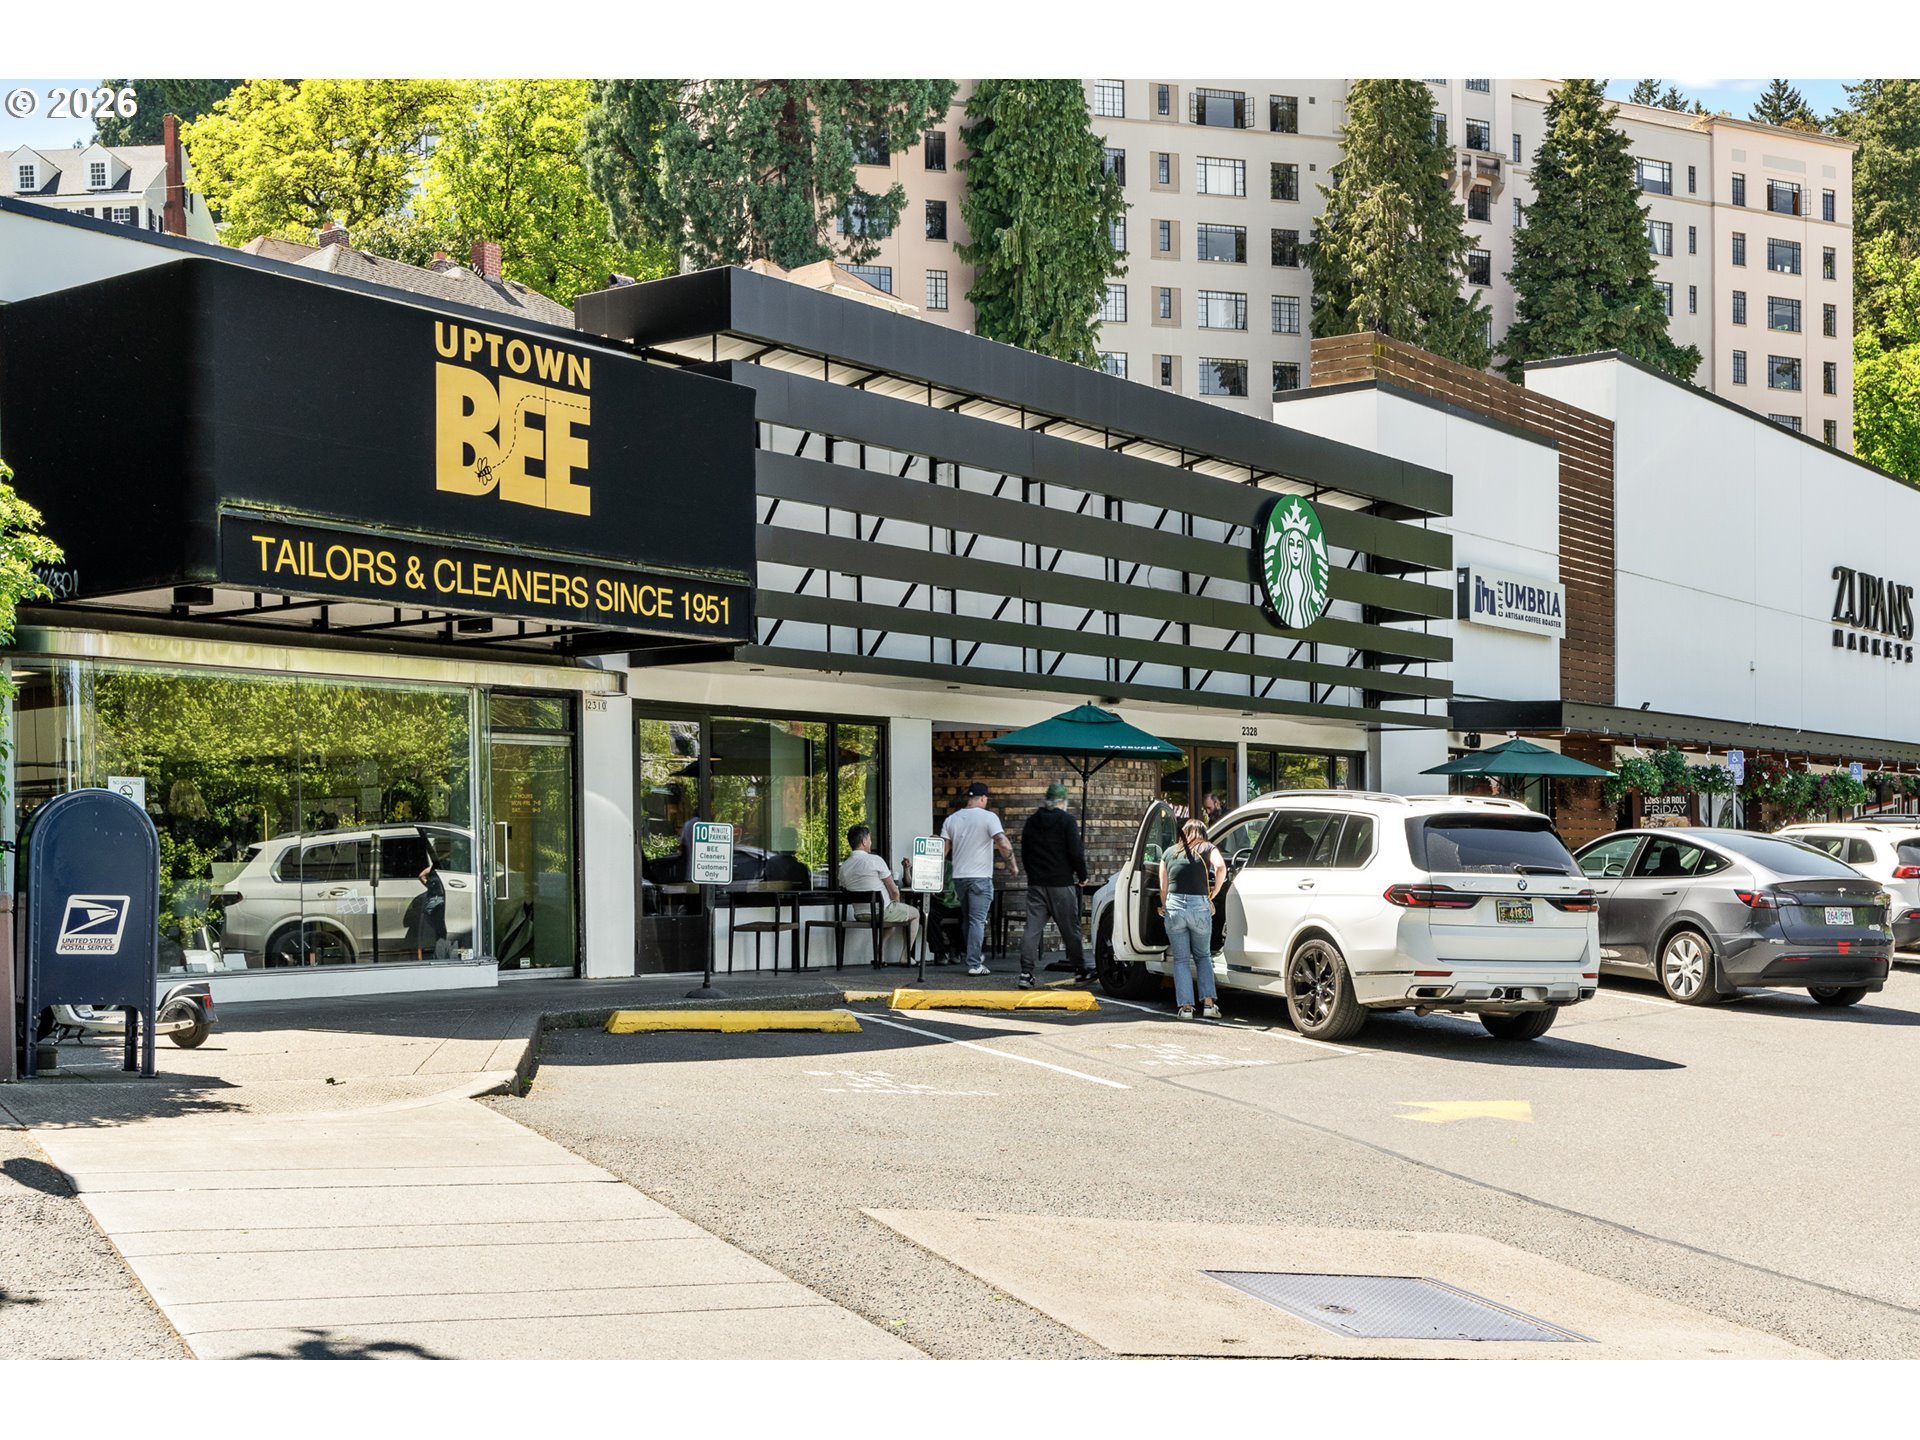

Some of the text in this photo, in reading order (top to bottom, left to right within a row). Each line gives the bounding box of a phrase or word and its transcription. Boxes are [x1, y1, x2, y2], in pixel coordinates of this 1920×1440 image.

[435, 321, 590, 389] UPTOWN
[436, 362, 591, 516] BEE
[252, 535, 729, 625] TAILORS & CLEANERS SINCE 1951
[1504, 581, 1561, 617] UMBRIA
[1505, 611, 1561, 628] ARTISAN COFFEE ROASTER
[1832, 629, 1913, 663] MARKETS
[587, 700, 607, 710] 2310
[1242, 726, 1258, 737] 2328
[696, 826, 708, 840] 10
[916, 840, 925, 853] 10
[697, 863, 728, 871] Customers
